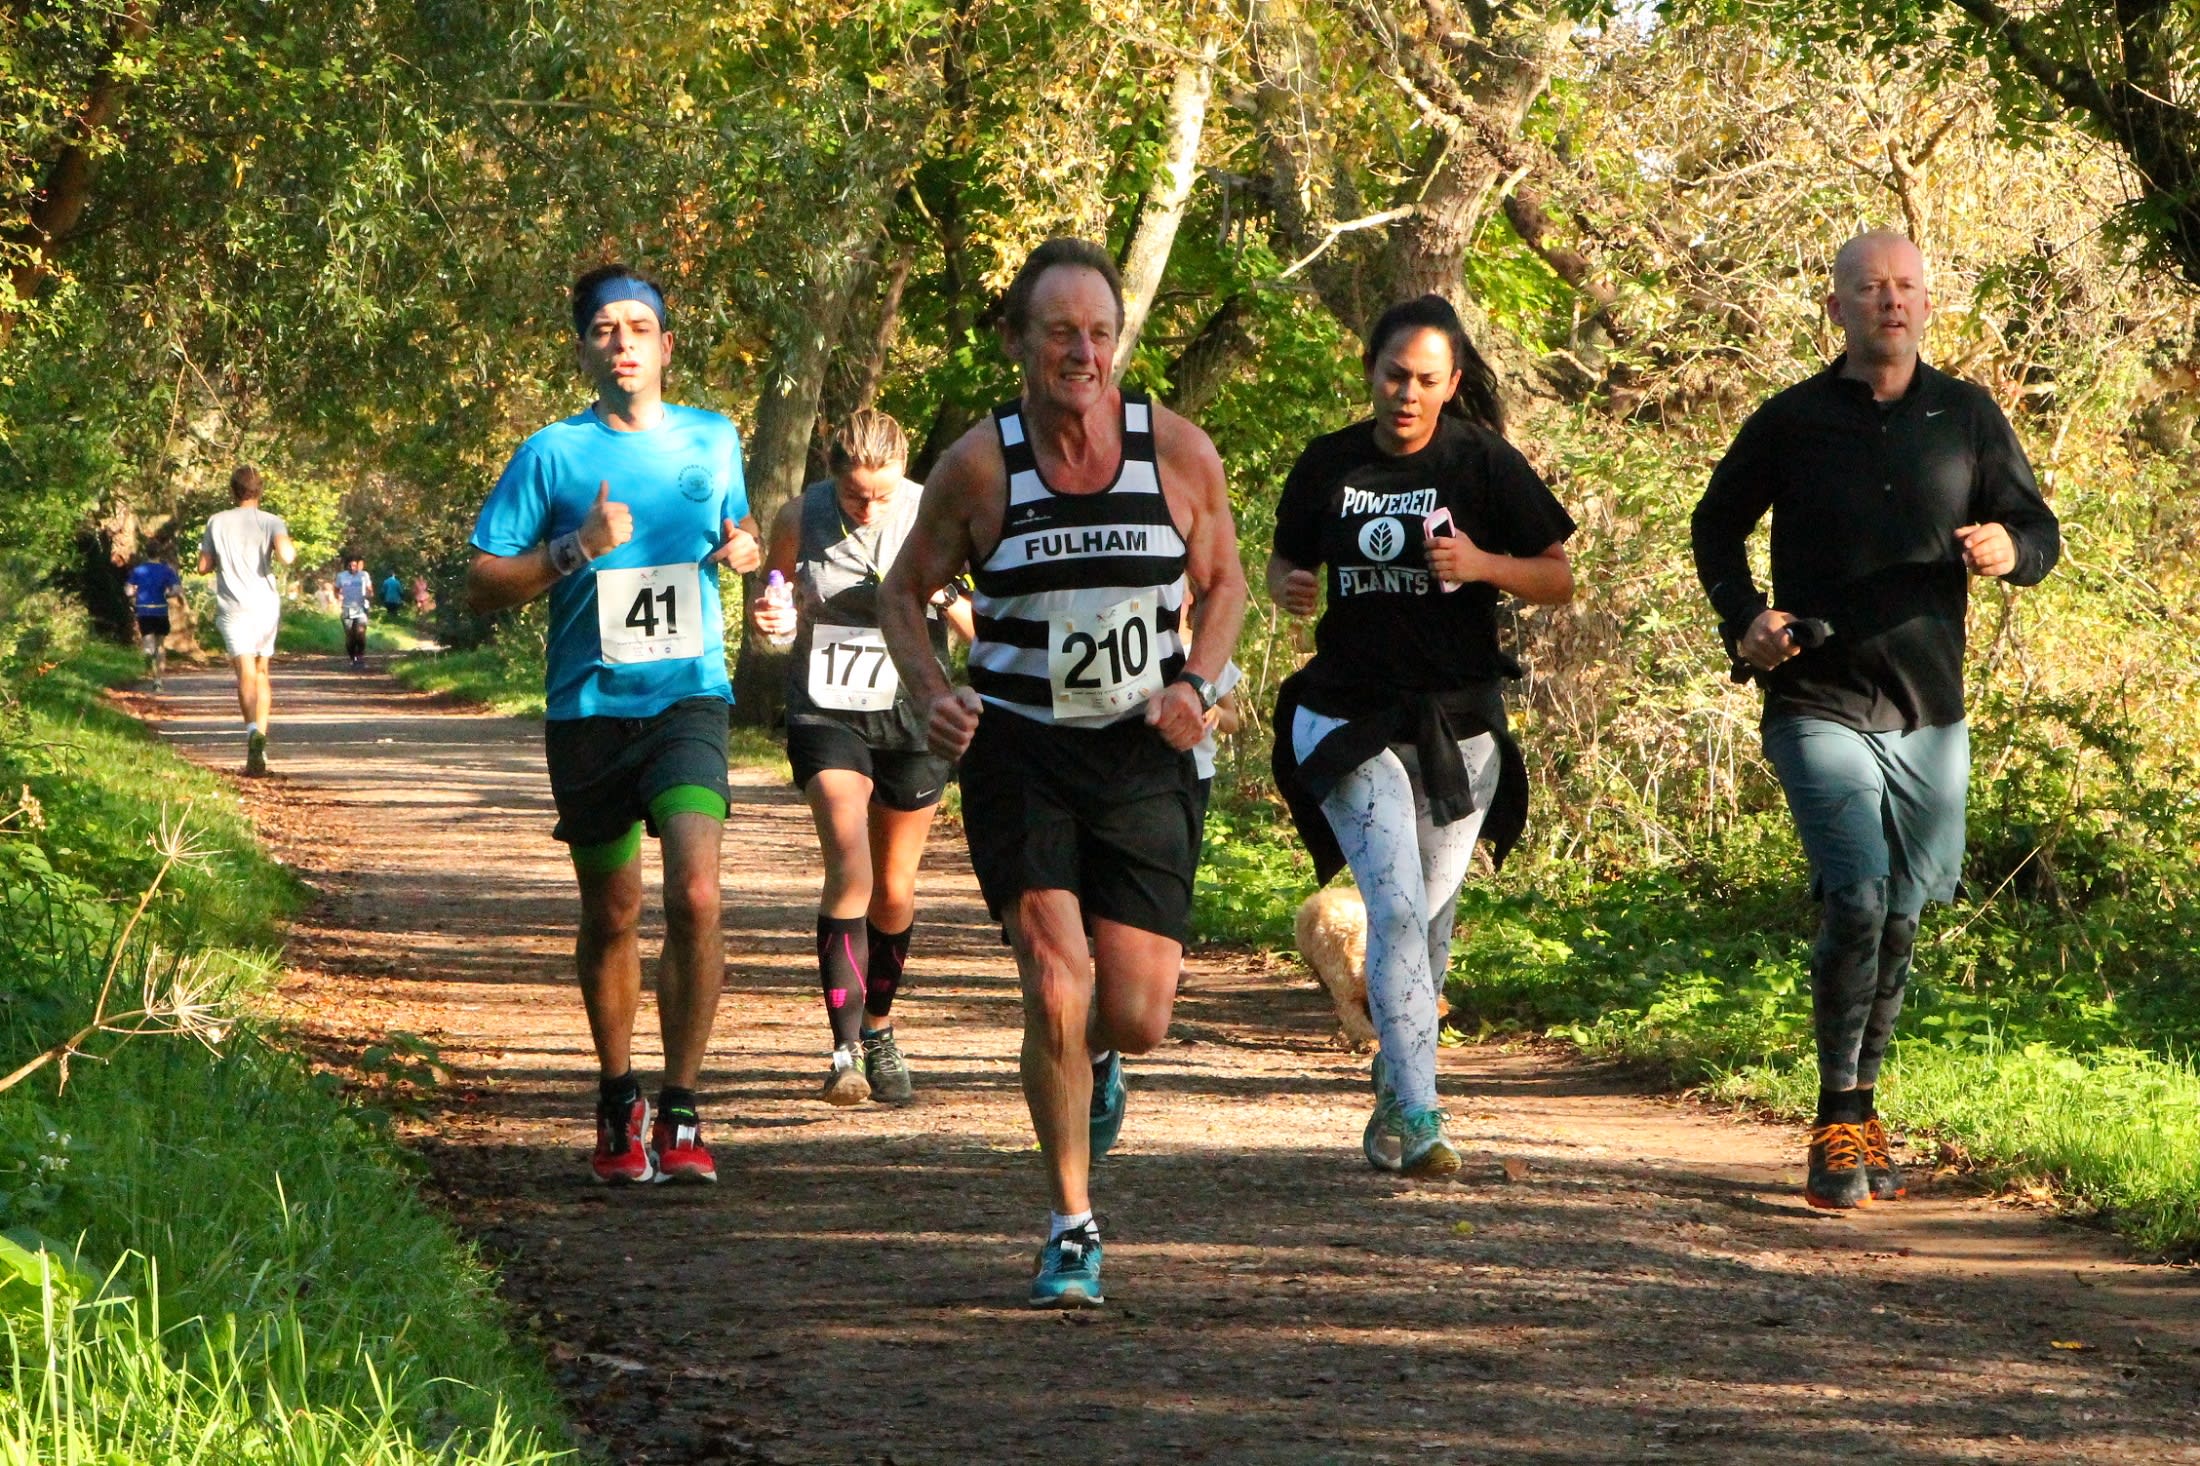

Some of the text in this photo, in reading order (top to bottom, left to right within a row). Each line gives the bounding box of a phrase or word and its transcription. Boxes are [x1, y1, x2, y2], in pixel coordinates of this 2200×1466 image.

[1341, 486, 1437, 518] POWERED
[1025, 530, 1147, 559] FULHAM
[1339, 569, 1429, 597] PLANTS
[625, 585, 677, 636] 41
[821, 642, 887, 688] 177
[1061, 616, 1148, 688] 210
